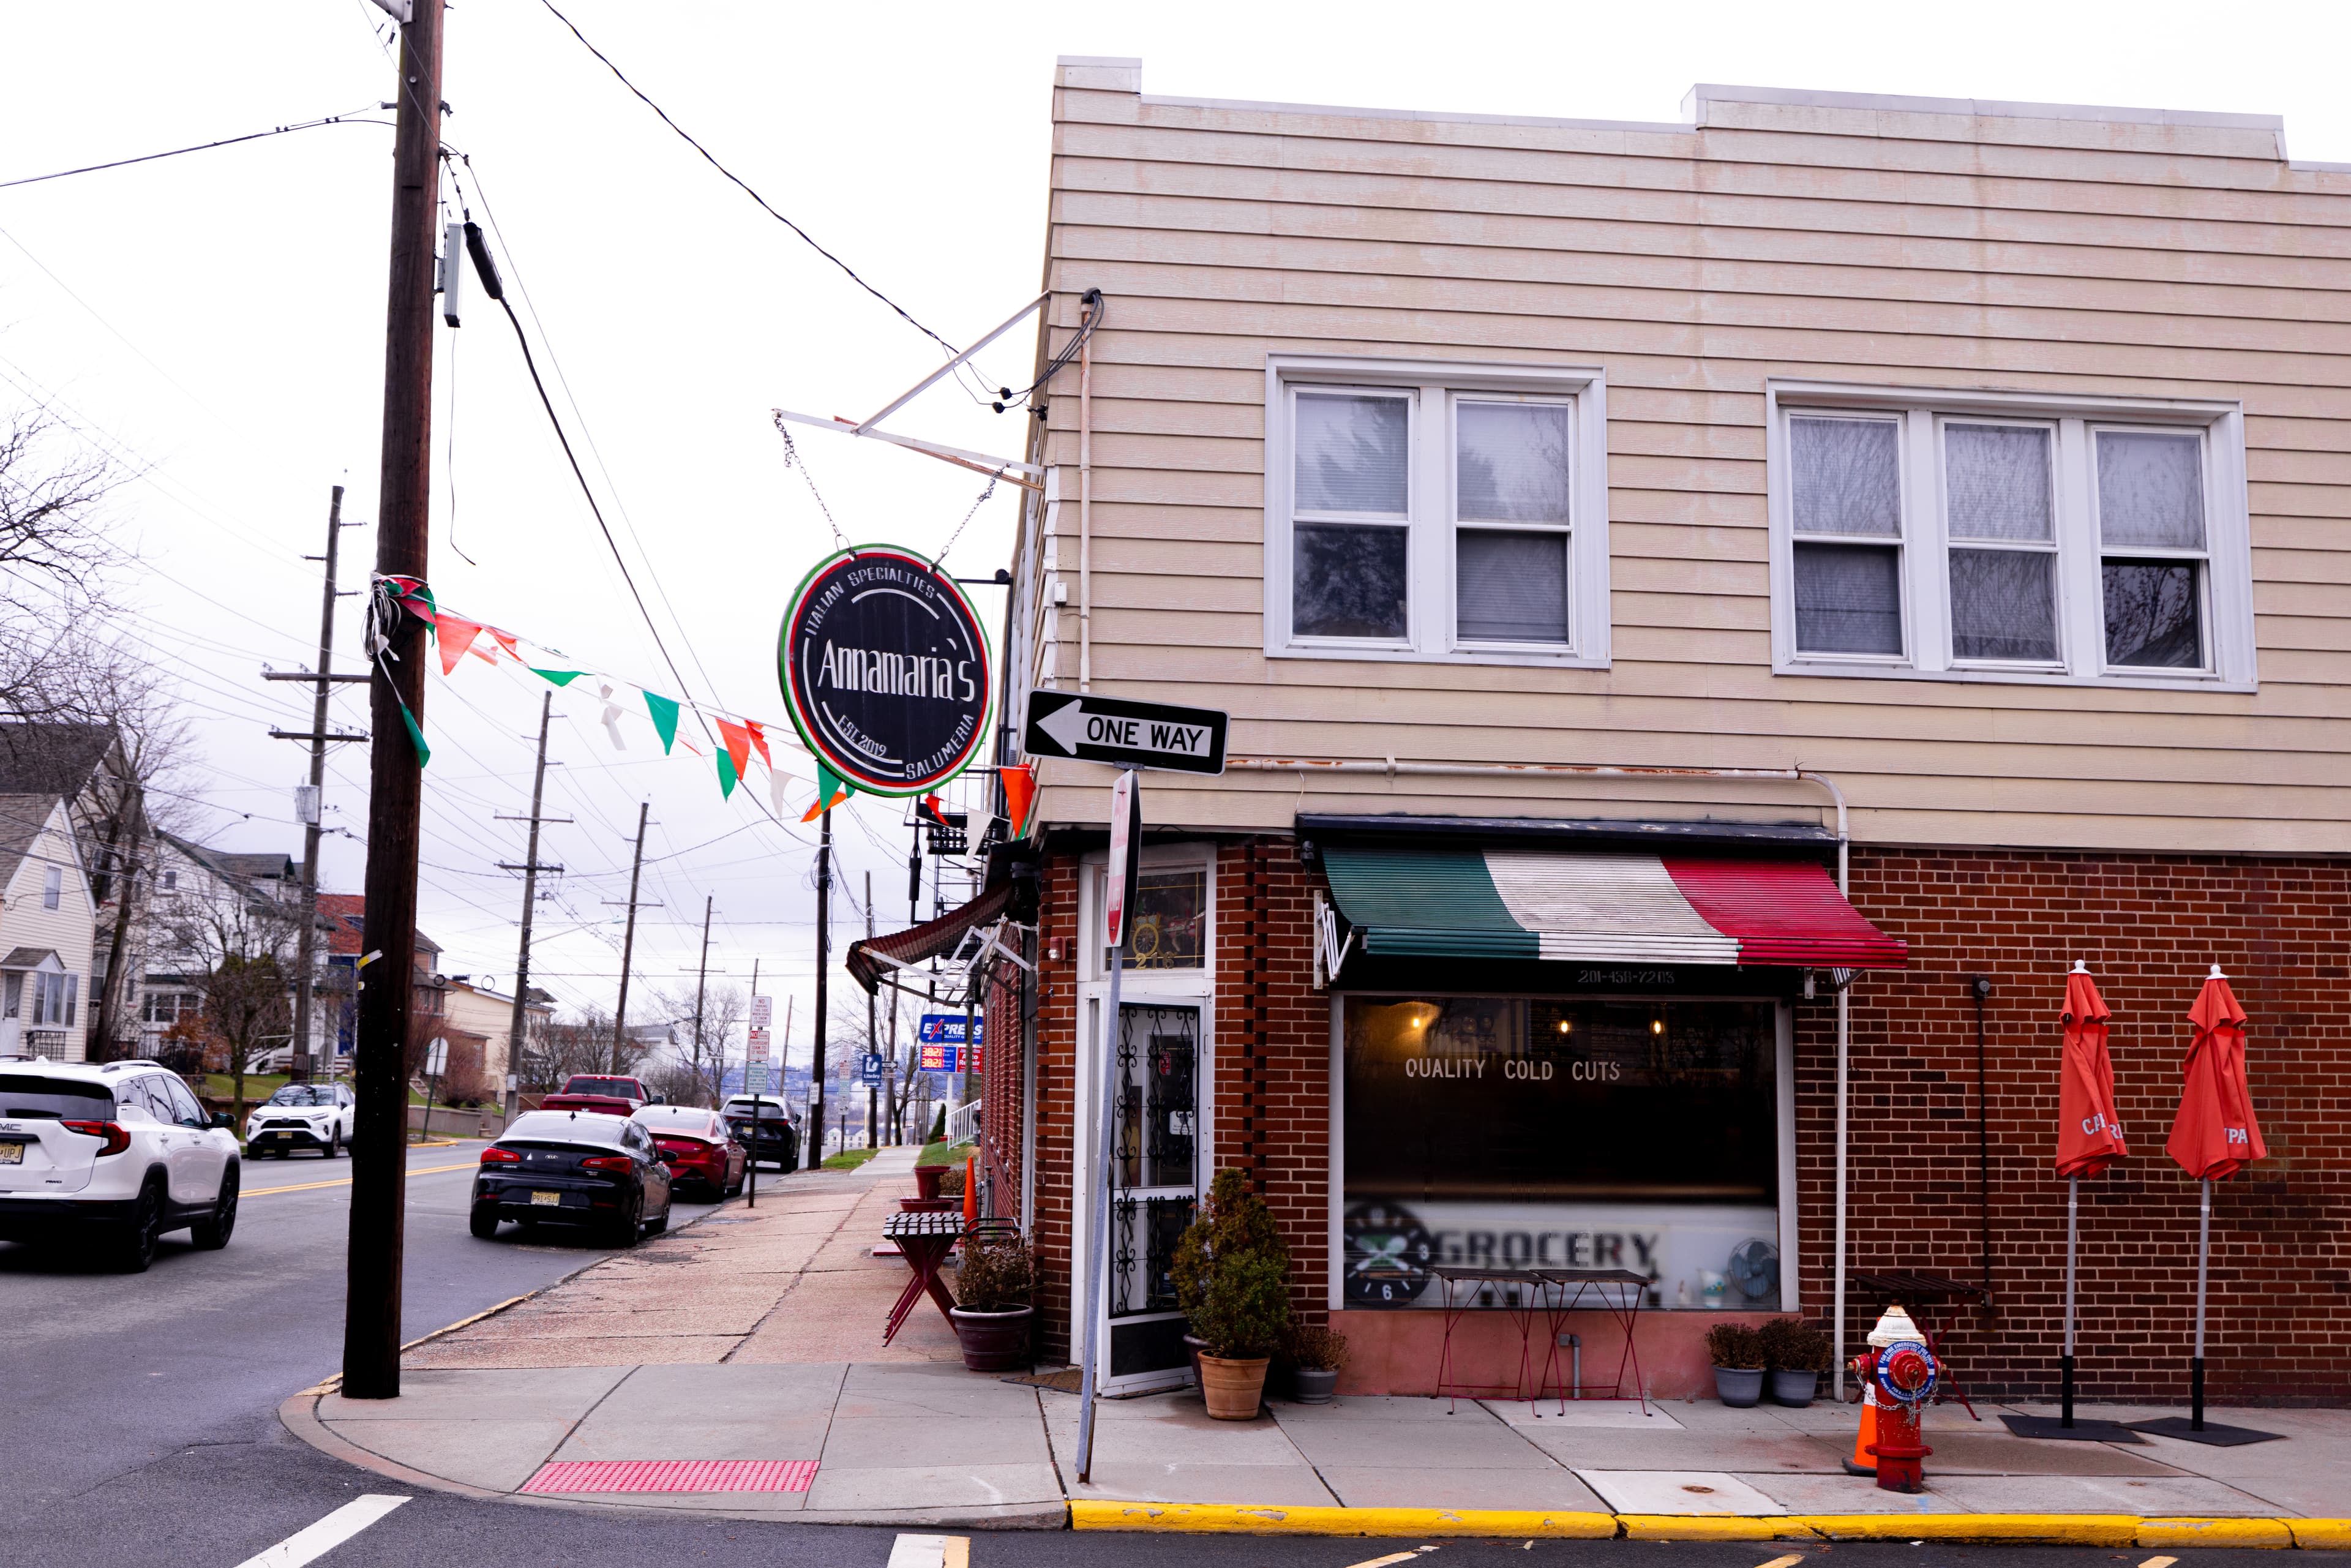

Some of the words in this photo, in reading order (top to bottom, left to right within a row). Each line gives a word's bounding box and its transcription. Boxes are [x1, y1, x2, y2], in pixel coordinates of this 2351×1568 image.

[804, 582, 844, 636] ITALIAN
[847, 567, 936, 599] SPECIALTIES
[817, 637, 975, 703] Annamaria's
[1087, 716, 1140, 746] ONE
[1150, 724, 1204, 752] WAY
[858, 735, 887, 757] 2019
[906, 713, 974, 779] SALUMERIA
[1135, 951, 1174, 970] 216
[923, 1019, 983, 1040] EXPRES
[1405, 1058, 1486, 1078] QUALITY
[1504, 1060, 1553, 1080] COLD
[1572, 1061, 1621, 1081] CUTS
[1435, 1230, 1659, 1267] GROCERY
[1382, 1285, 1392, 1300] 6
[1884, 1346, 1894, 1355] FIRE
